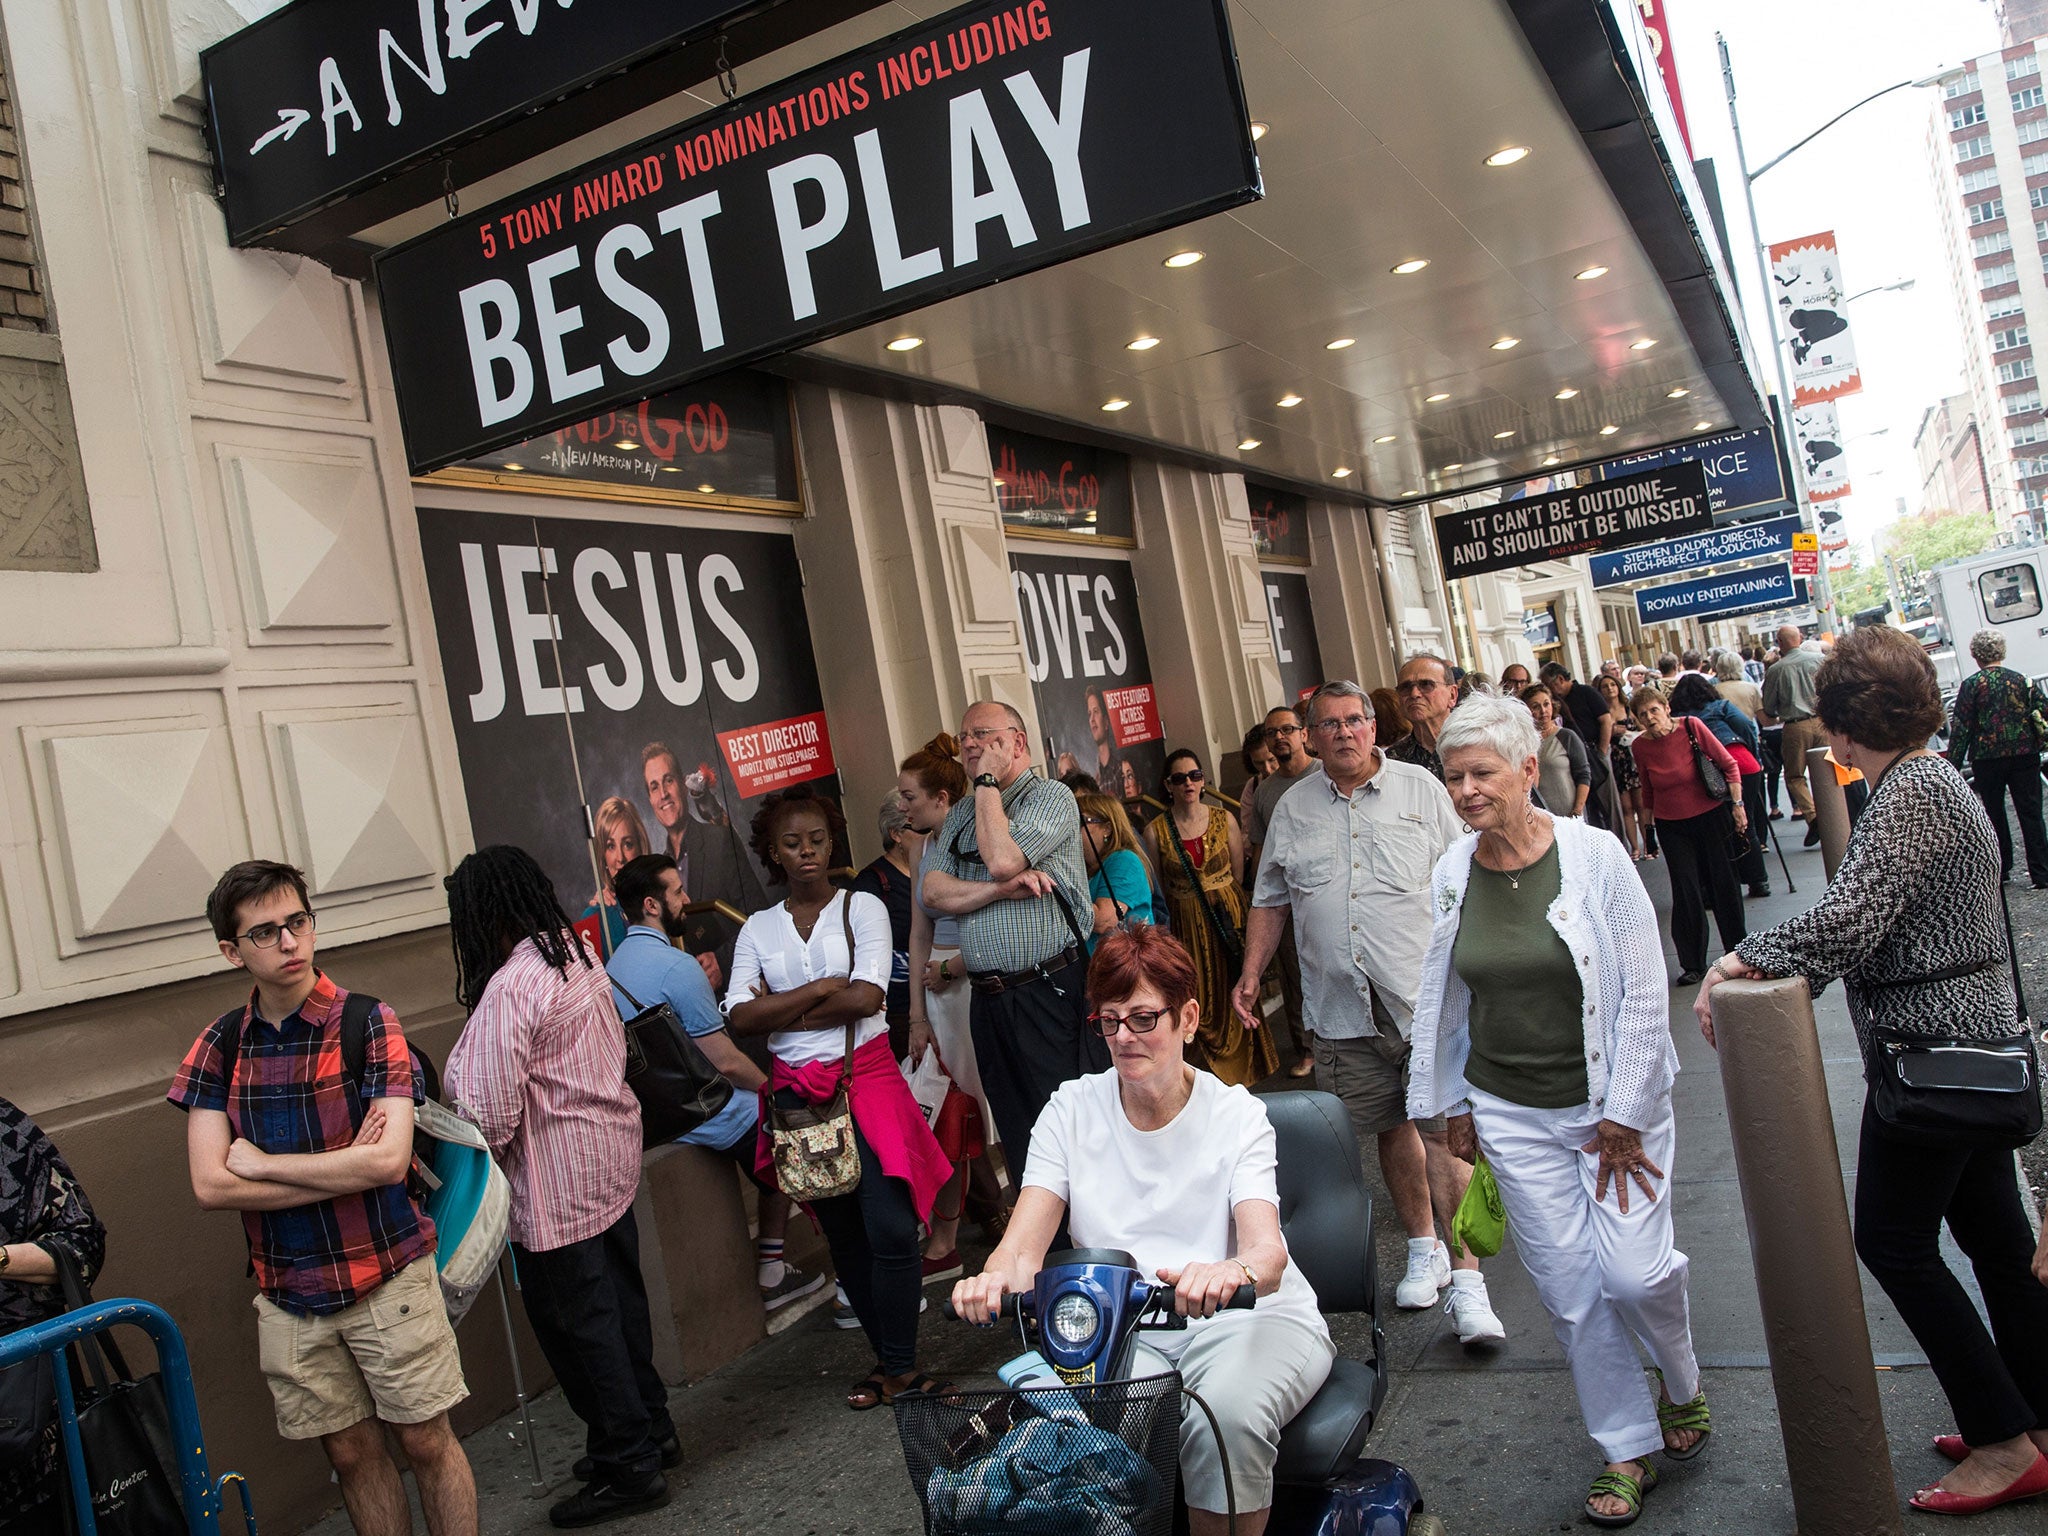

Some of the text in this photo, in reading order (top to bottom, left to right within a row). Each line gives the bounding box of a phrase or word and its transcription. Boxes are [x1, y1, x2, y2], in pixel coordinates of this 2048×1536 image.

[319, 57, 362, 156] A
[480, 224, 497, 259] 5
[500, 194, 564, 251] TONY
[674, 71, 869, 180] NOMINATIONS
[878, 0, 1051, 99] INCLUDING
[459, 47, 1091, 428] BEST PLAY
[551, 445, 658, 481] A NEW AMERICAN PLAY
[993, 442, 1051, 509] HAND
[1059, 460, 1100, 515] GOD
[1550, 498, 1574, 523] BE
[1452, 542, 1488, 566] AND
[1493, 520, 1590, 558] SHOULDN’T
[1595, 512, 1619, 536] BE
[1579, 539, 1603, 549] NEWS
[1674, 537, 1716, 554] DALDRY
[1721, 526, 1766, 544] DIRECTS
[1611, 567, 1619, 578] A
[1623, 550, 1702, 575] PITCH-PERFECT
[459, 543, 760, 723] JESUS
[1106, 687, 1151, 709] BEST FEATURED
[1120, 705, 1146, 725] ACTRESS
[728, 721, 820, 762] BEST DIRECTOR
[738, 746, 820, 778] MORITZ VON STUELPNAGEL
[110, 1469, 149, 1498] Center
